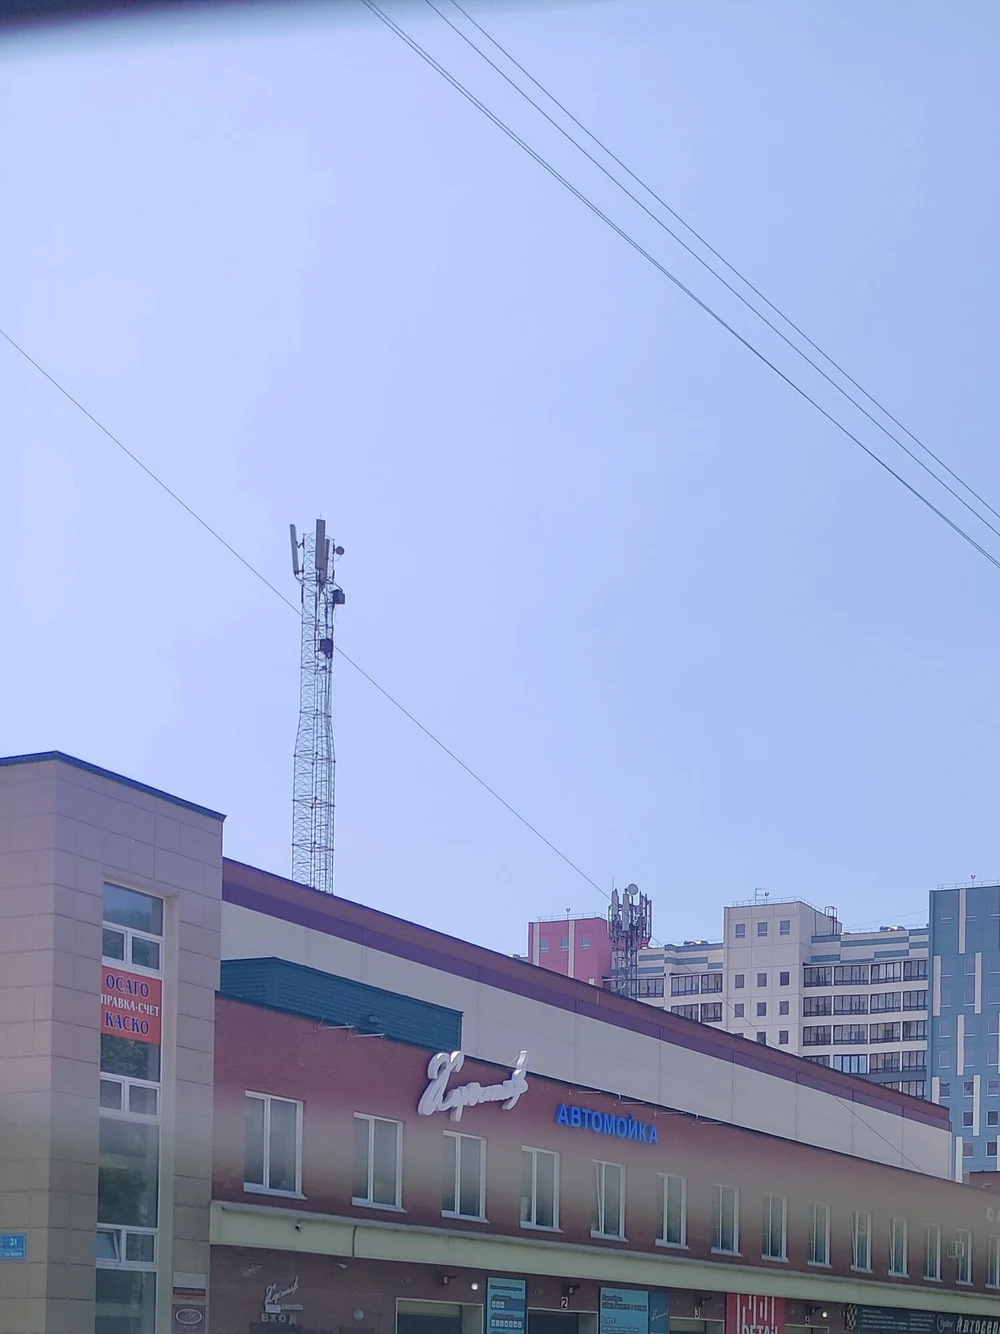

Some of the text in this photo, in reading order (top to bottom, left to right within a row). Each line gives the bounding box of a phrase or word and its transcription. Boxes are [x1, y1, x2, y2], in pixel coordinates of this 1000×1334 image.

[105, 973, 149, 998] ОСАГО
[105, 1011, 150, 1035] КАСКО
[555, 1103, 659, 1145] АВТОМОЙКА
[561, 1297, 569, 1309] 2
[260, 1313, 297, 1326] ВХОД
[695, 1307, 700, 1318] 3
